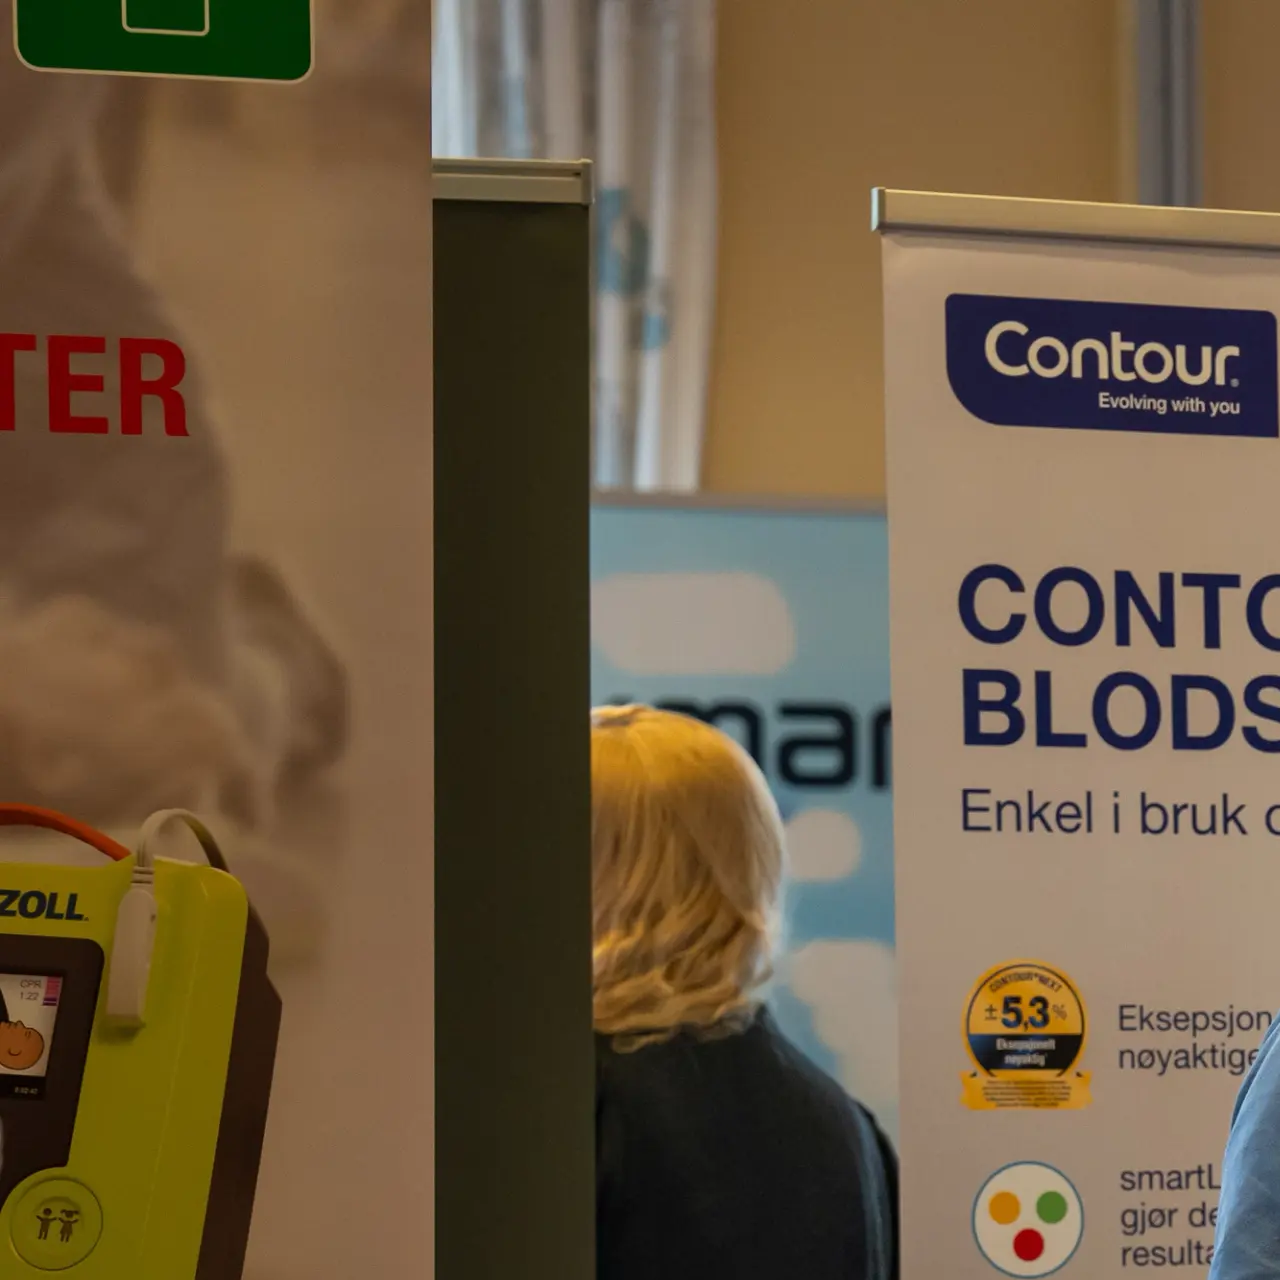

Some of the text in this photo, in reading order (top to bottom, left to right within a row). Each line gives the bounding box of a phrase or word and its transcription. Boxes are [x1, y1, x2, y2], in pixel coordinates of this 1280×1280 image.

[1099, 392, 1240, 417] Evolving with you
[961, 788, 1093, 833] Enkel
[1112, 791, 1120, 833] i
[1140, 791, 1248, 835] bruk
[0, 889, 84, 921] ZOLL
[1118, 1004, 1272, 1037] Eksepsjon
[1121, 1202, 1178, 1235] gjør
